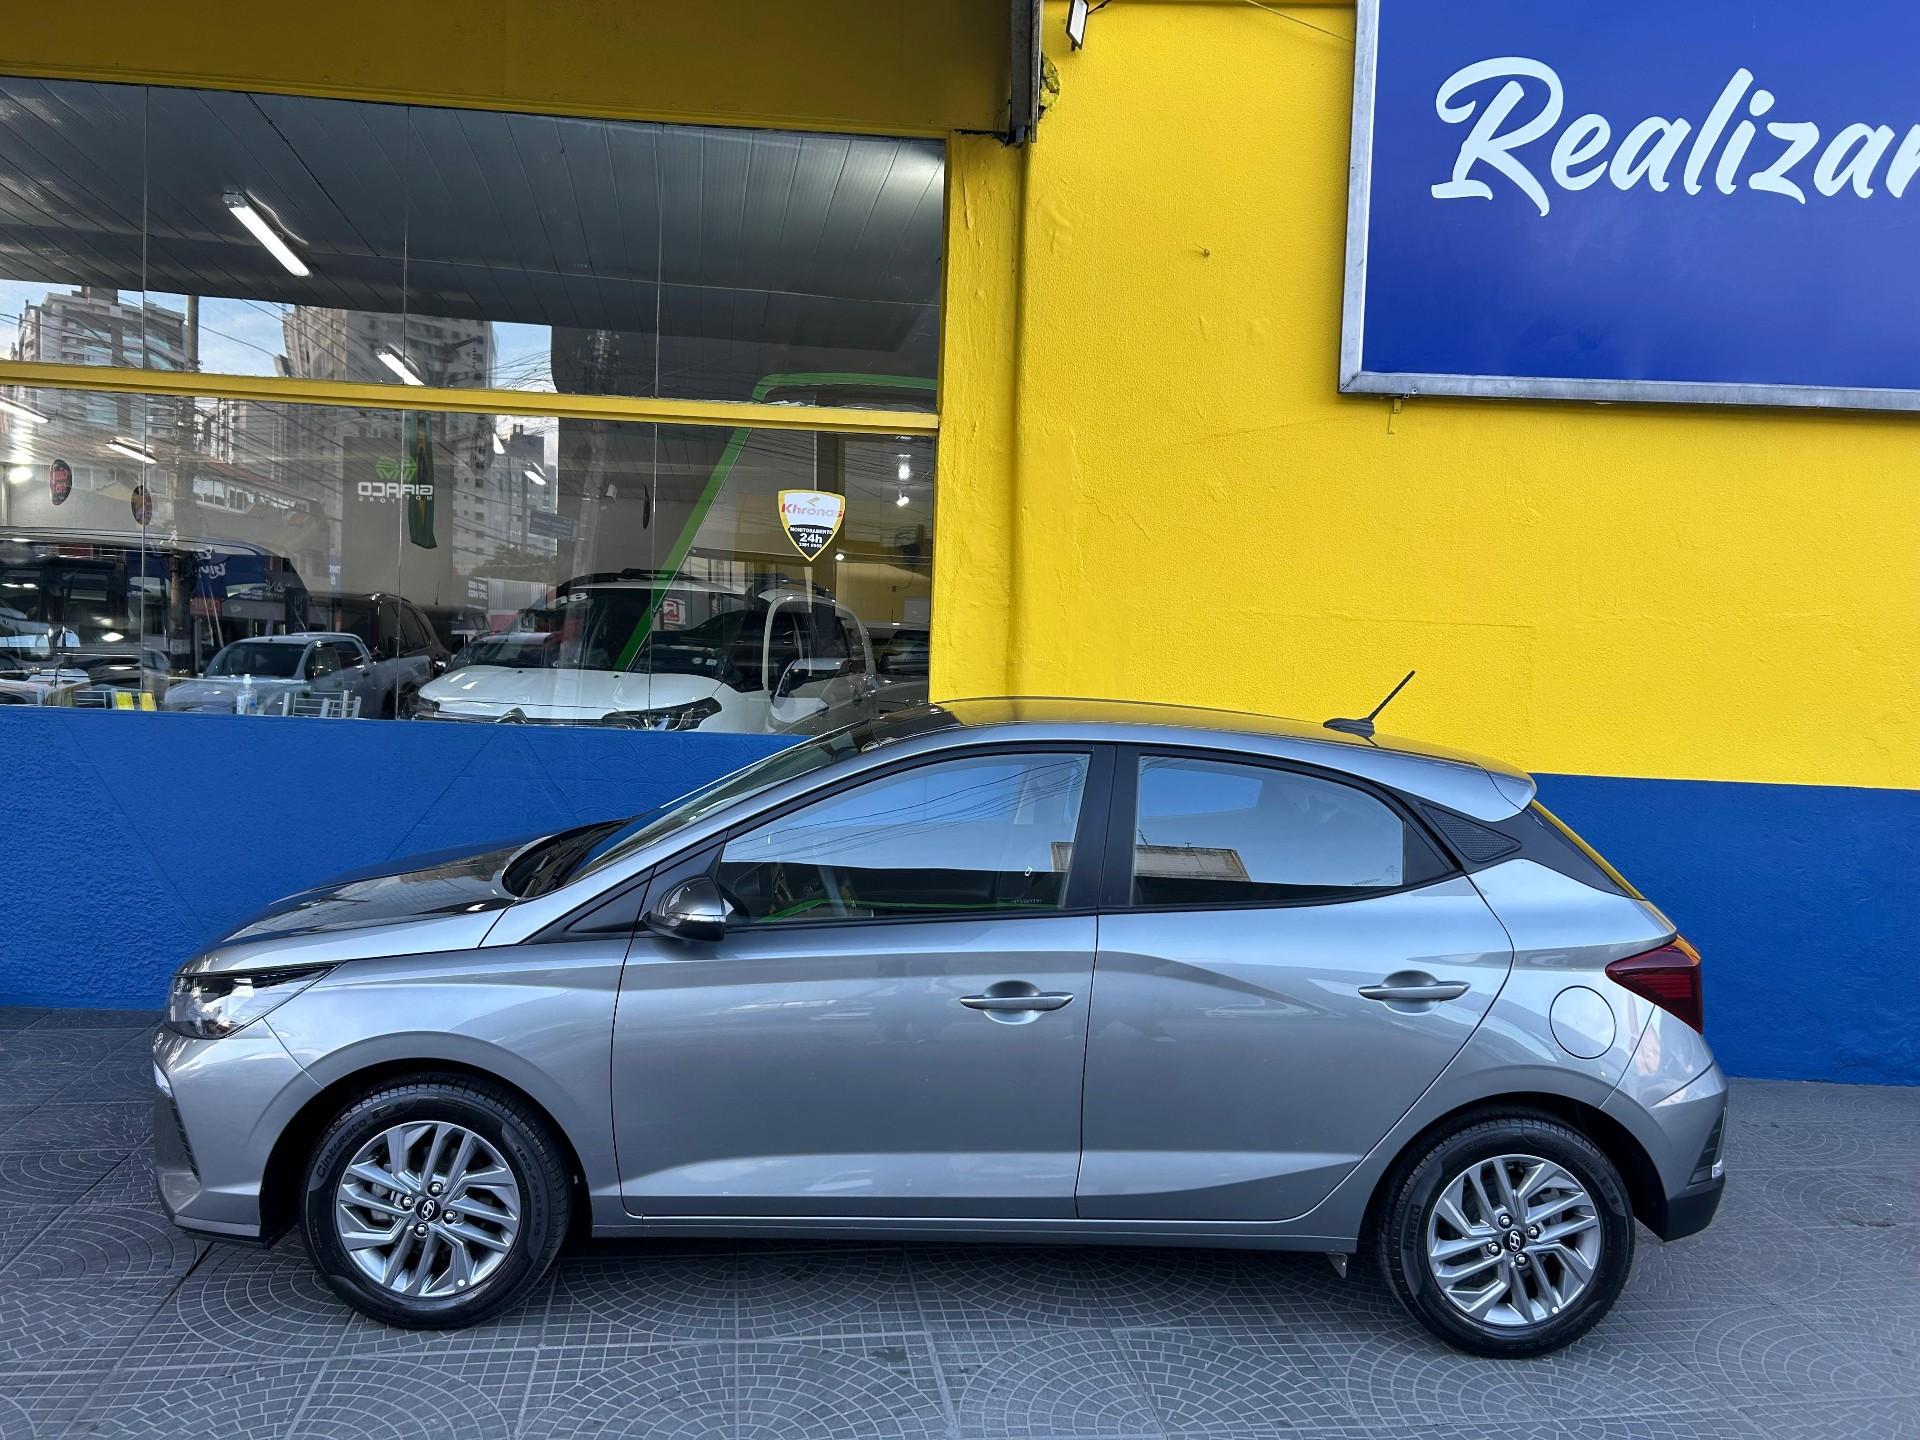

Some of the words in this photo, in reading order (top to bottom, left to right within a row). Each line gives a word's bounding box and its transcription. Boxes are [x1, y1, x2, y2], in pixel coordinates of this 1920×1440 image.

[781, 503, 843, 518] Khronos
[790, 526, 833, 535] MONITORAMENTO
[799, 532, 823, 544] 24h
